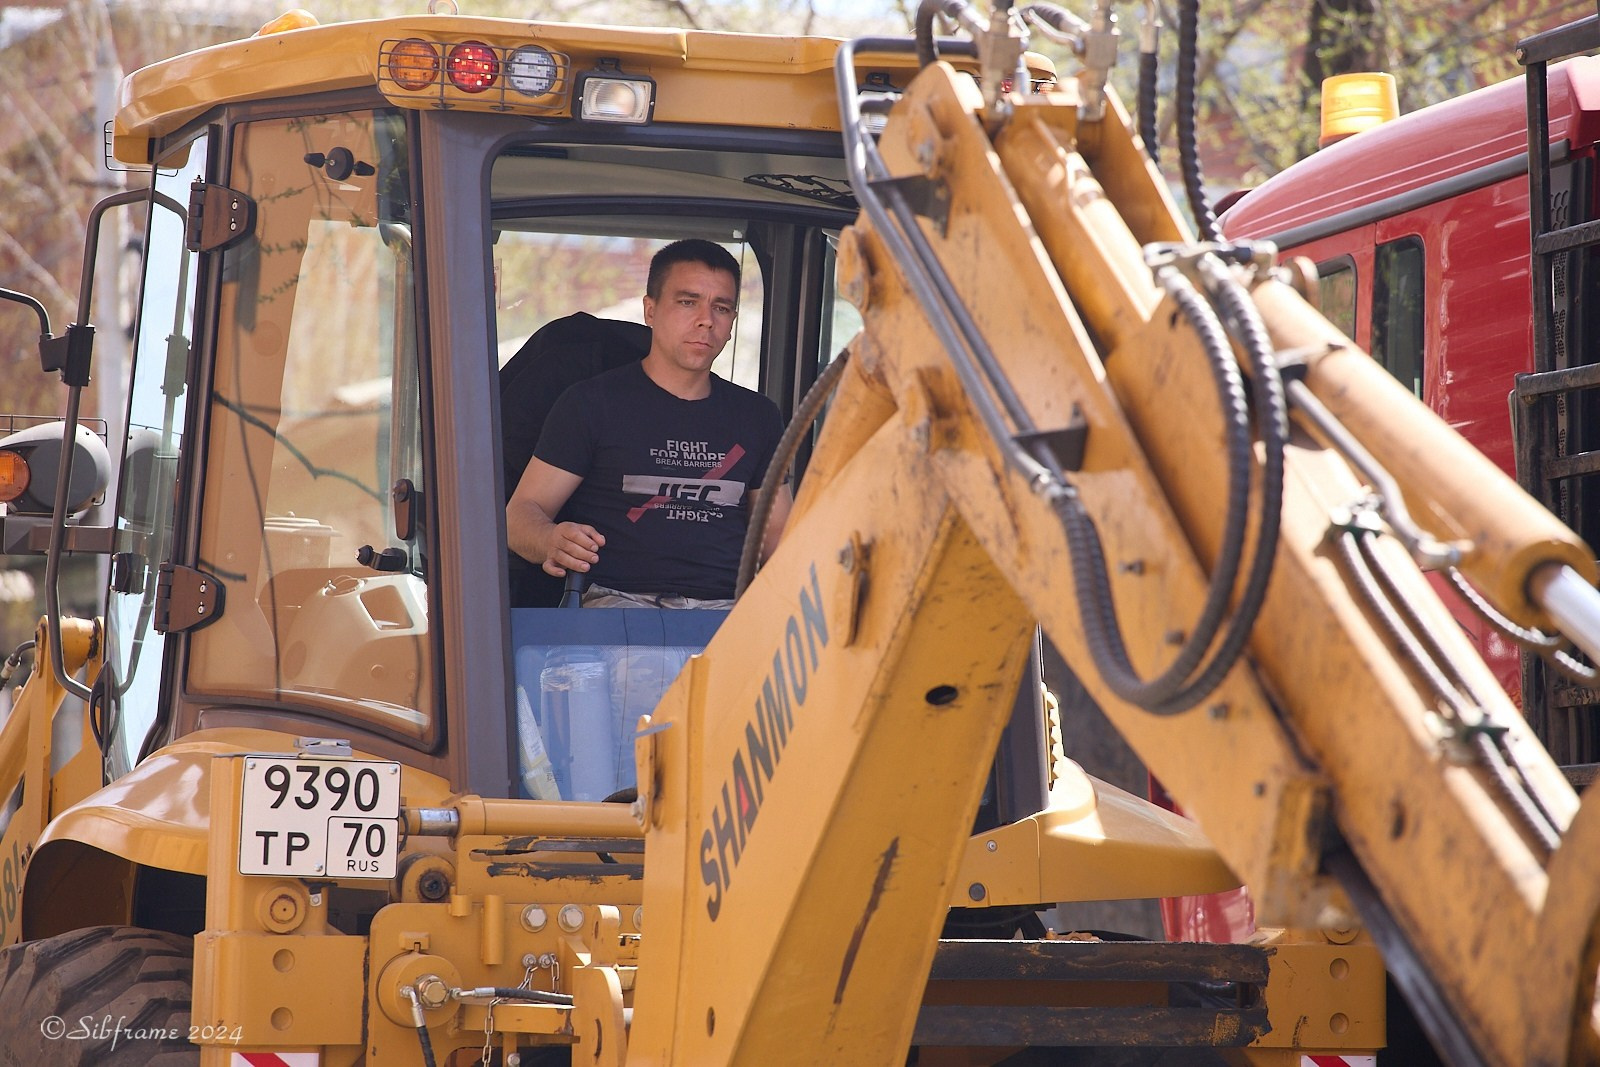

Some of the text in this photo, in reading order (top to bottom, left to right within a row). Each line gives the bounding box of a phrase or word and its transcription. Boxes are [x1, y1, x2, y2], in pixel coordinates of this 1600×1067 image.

[650, 448, 726, 461] FOR MORE
[666, 440, 708, 453] FIGHT
[655, 458, 682, 467] BREAK
[700, 560, 829, 922] SHANMON
[264, 764, 380, 812] 9390
[255, 830, 310, 866] TP
[343, 823, 386, 857] 70
[347, 860, 379, 872] RUS
